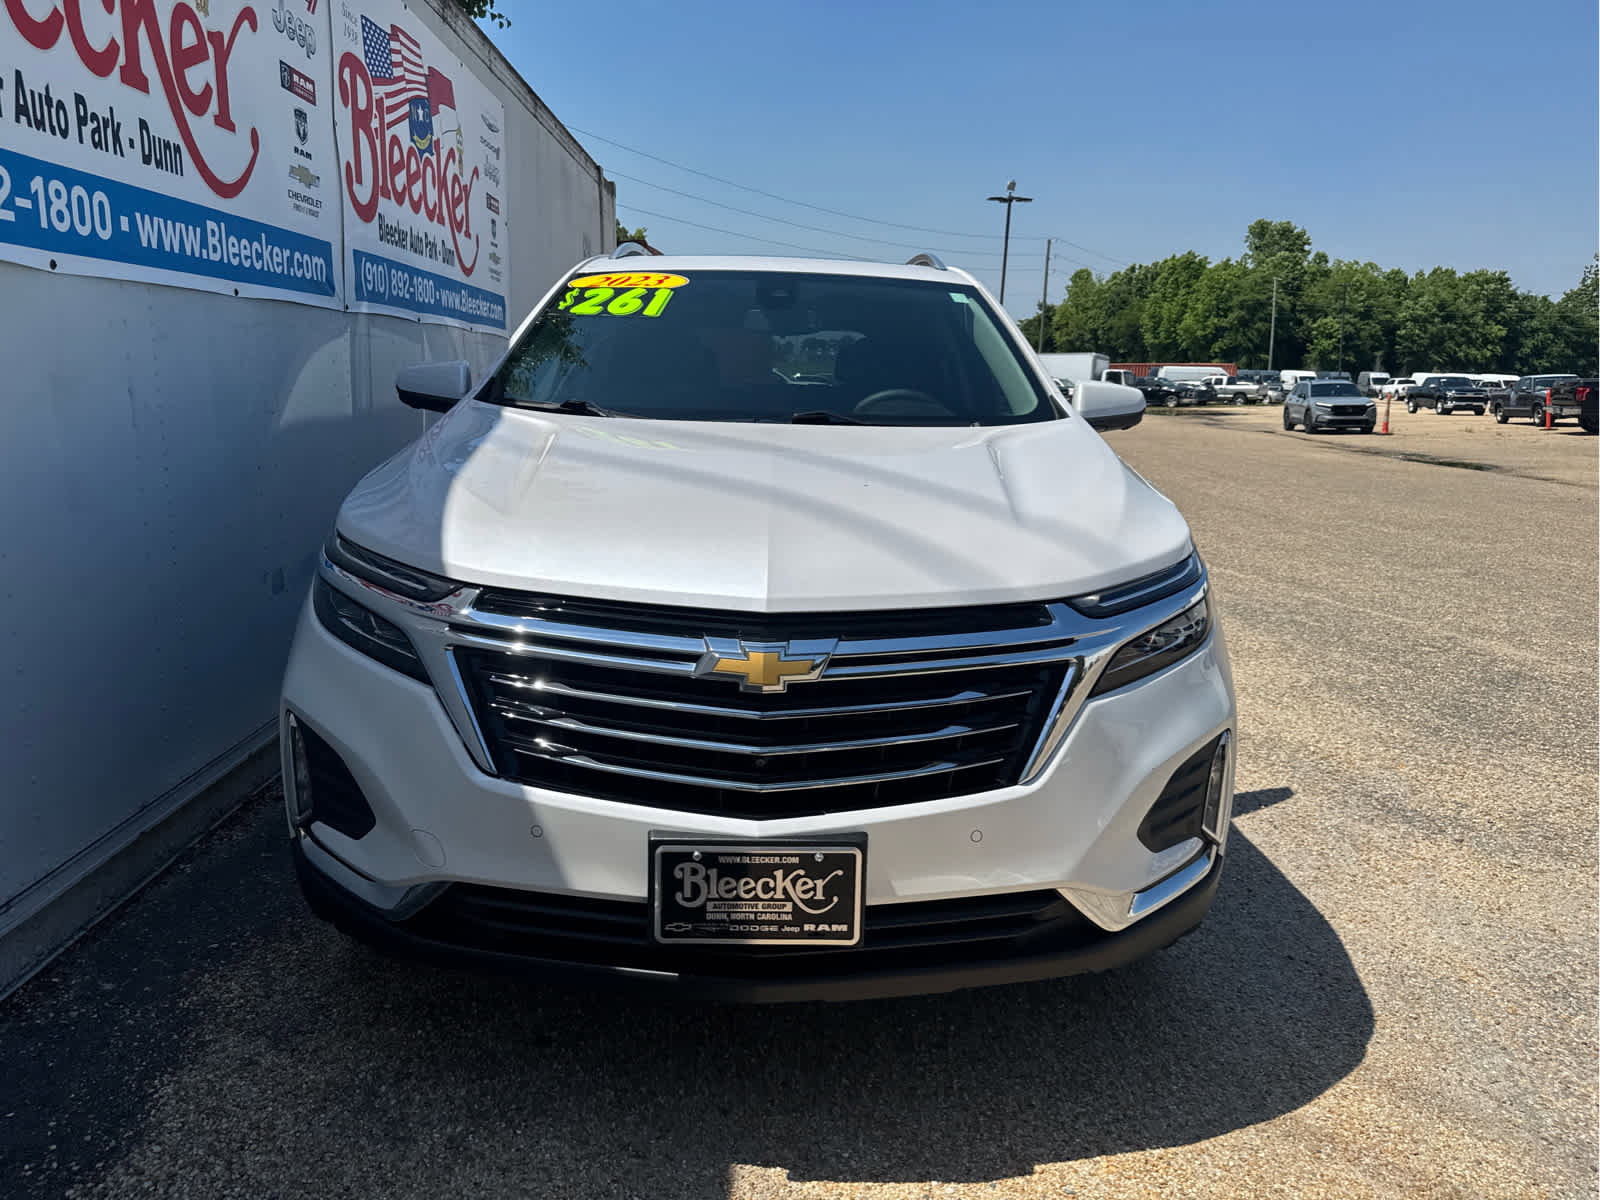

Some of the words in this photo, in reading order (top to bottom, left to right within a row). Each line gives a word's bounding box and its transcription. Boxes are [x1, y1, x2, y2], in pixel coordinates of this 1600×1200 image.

[272, 0, 316, 60] Jeep
[14, 68, 69, 140] Auto
[74, 91, 124, 158] Park
[138, 116, 184, 176] Dunn
[293, 146, 312, 160] RAM
[339, 52, 479, 278] Bleecker
[287, 189, 322, 209] CHEVROLET
[134, 212, 328, 283] www.Bleecker.com
[378, 212, 409, 251] Bleecker
[409, 226, 424, 257] Auto
[424, 231, 439, 262] Park
[361, 256, 389, 301] (910)
[390, 268, 435, 305] 892-1800
[440, 288, 504, 321] www.Bleecker.com
[589, 275, 671, 287] 2023
[558, 288, 674, 317] $261
[712, 902, 760, 911] AUTOMOTIVE
[761, 902, 788, 911] GROUP
[730, 912, 755, 922] NORTH
[756, 912, 793, 922] CAROLINA
[780, 924, 801, 933] Jeep
[803, 923, 849, 932] RAM
